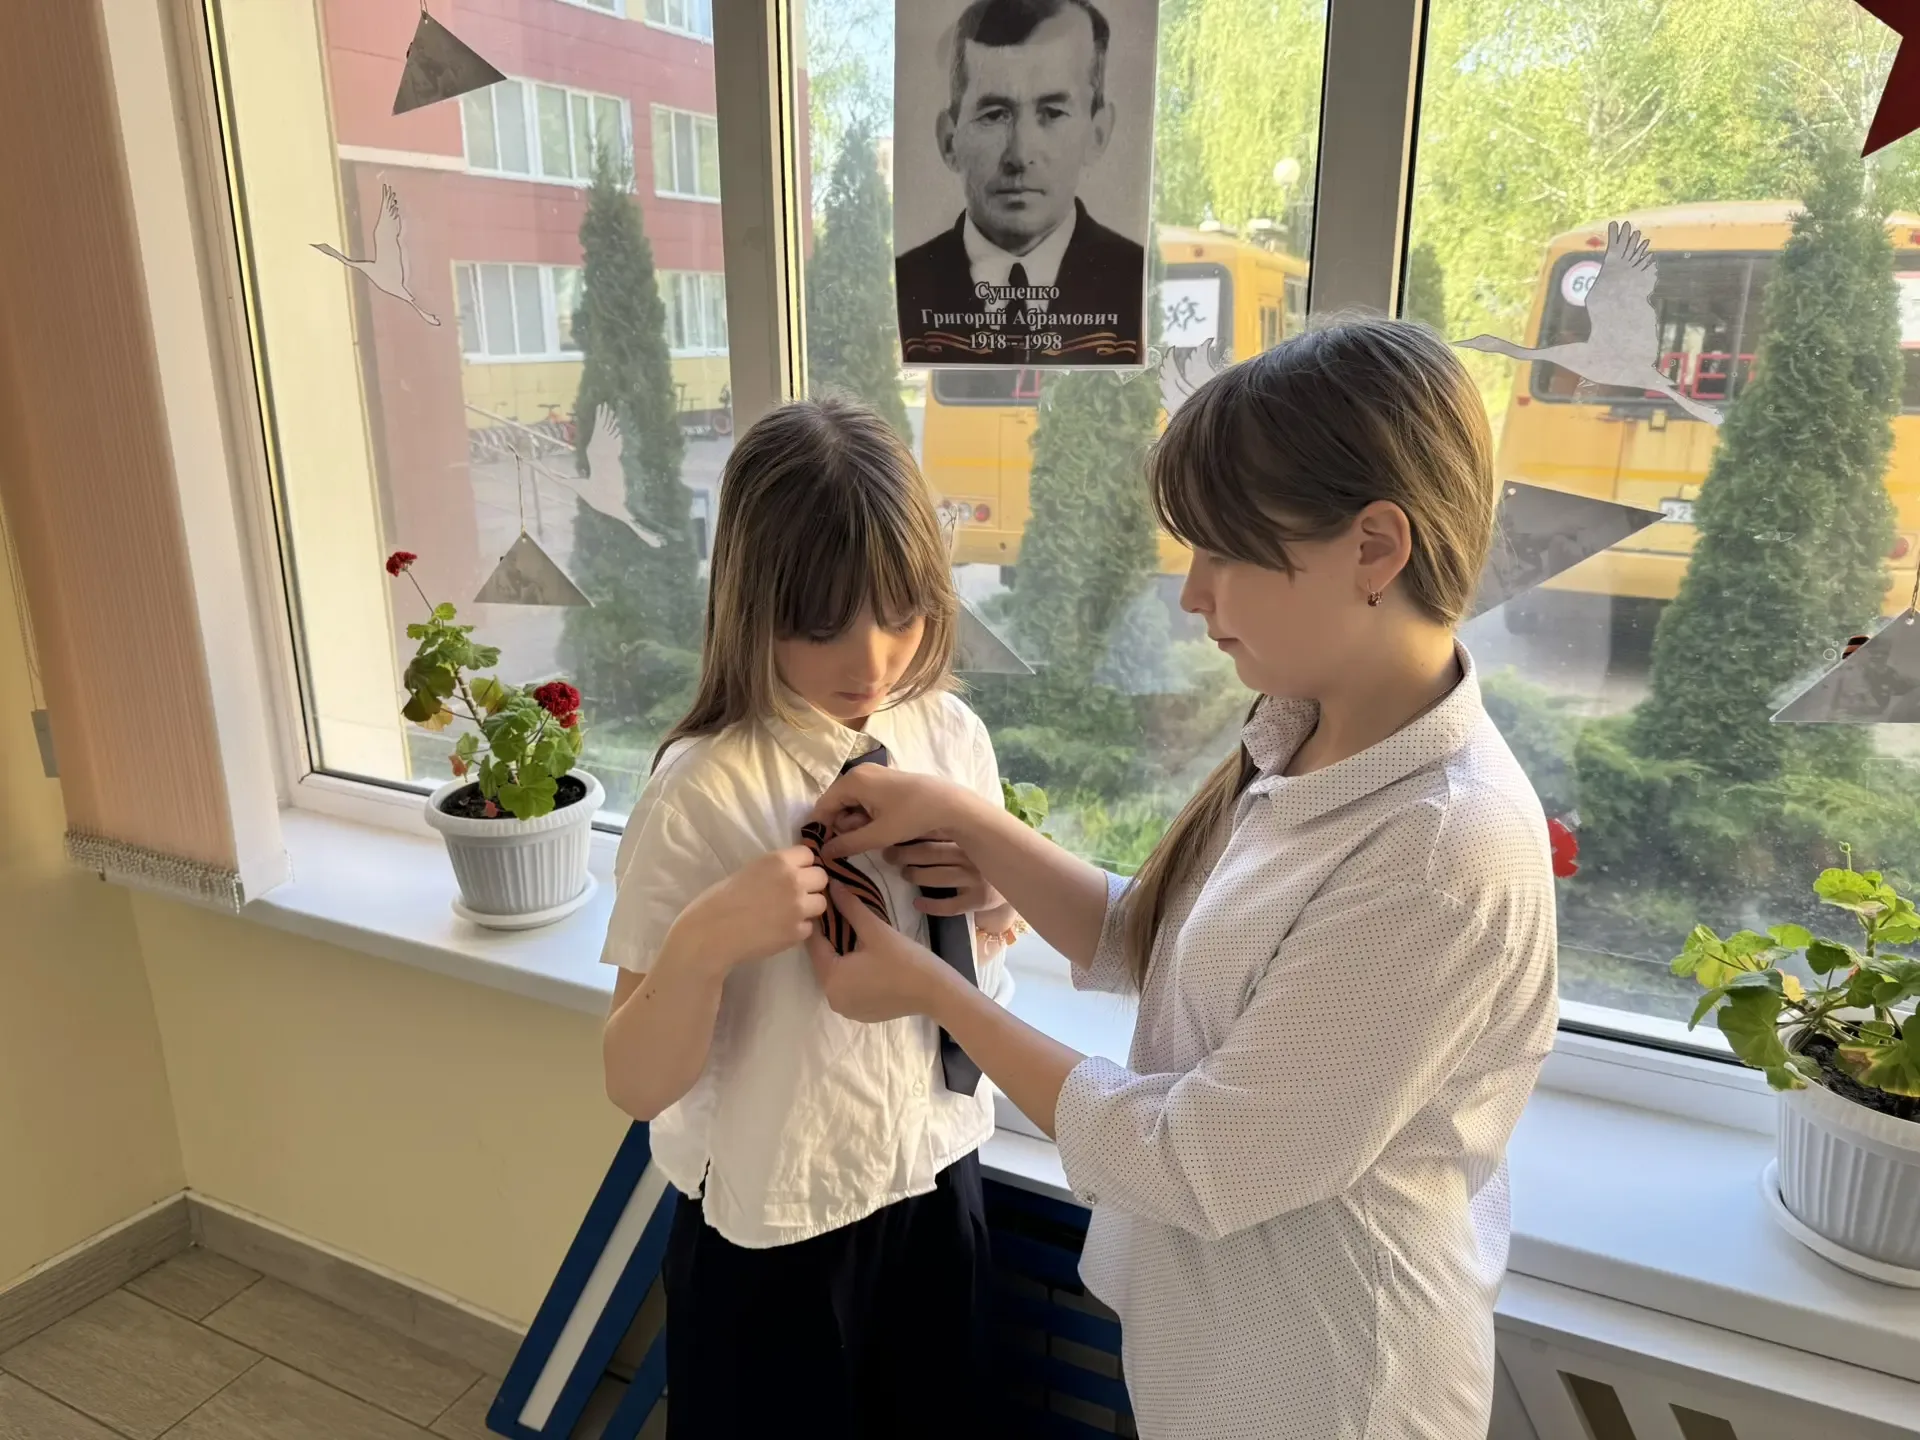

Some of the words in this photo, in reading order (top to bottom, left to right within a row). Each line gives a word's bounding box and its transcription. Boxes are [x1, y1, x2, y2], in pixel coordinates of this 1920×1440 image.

[974, 281, 1060, 304] Сущенко
[921, 309, 1007, 328] Григорий
[1013, 308, 1119, 329] Абрамович
[969, 333, 1006, 350] 1918
[1023, 334, 1063, 350] 1998
